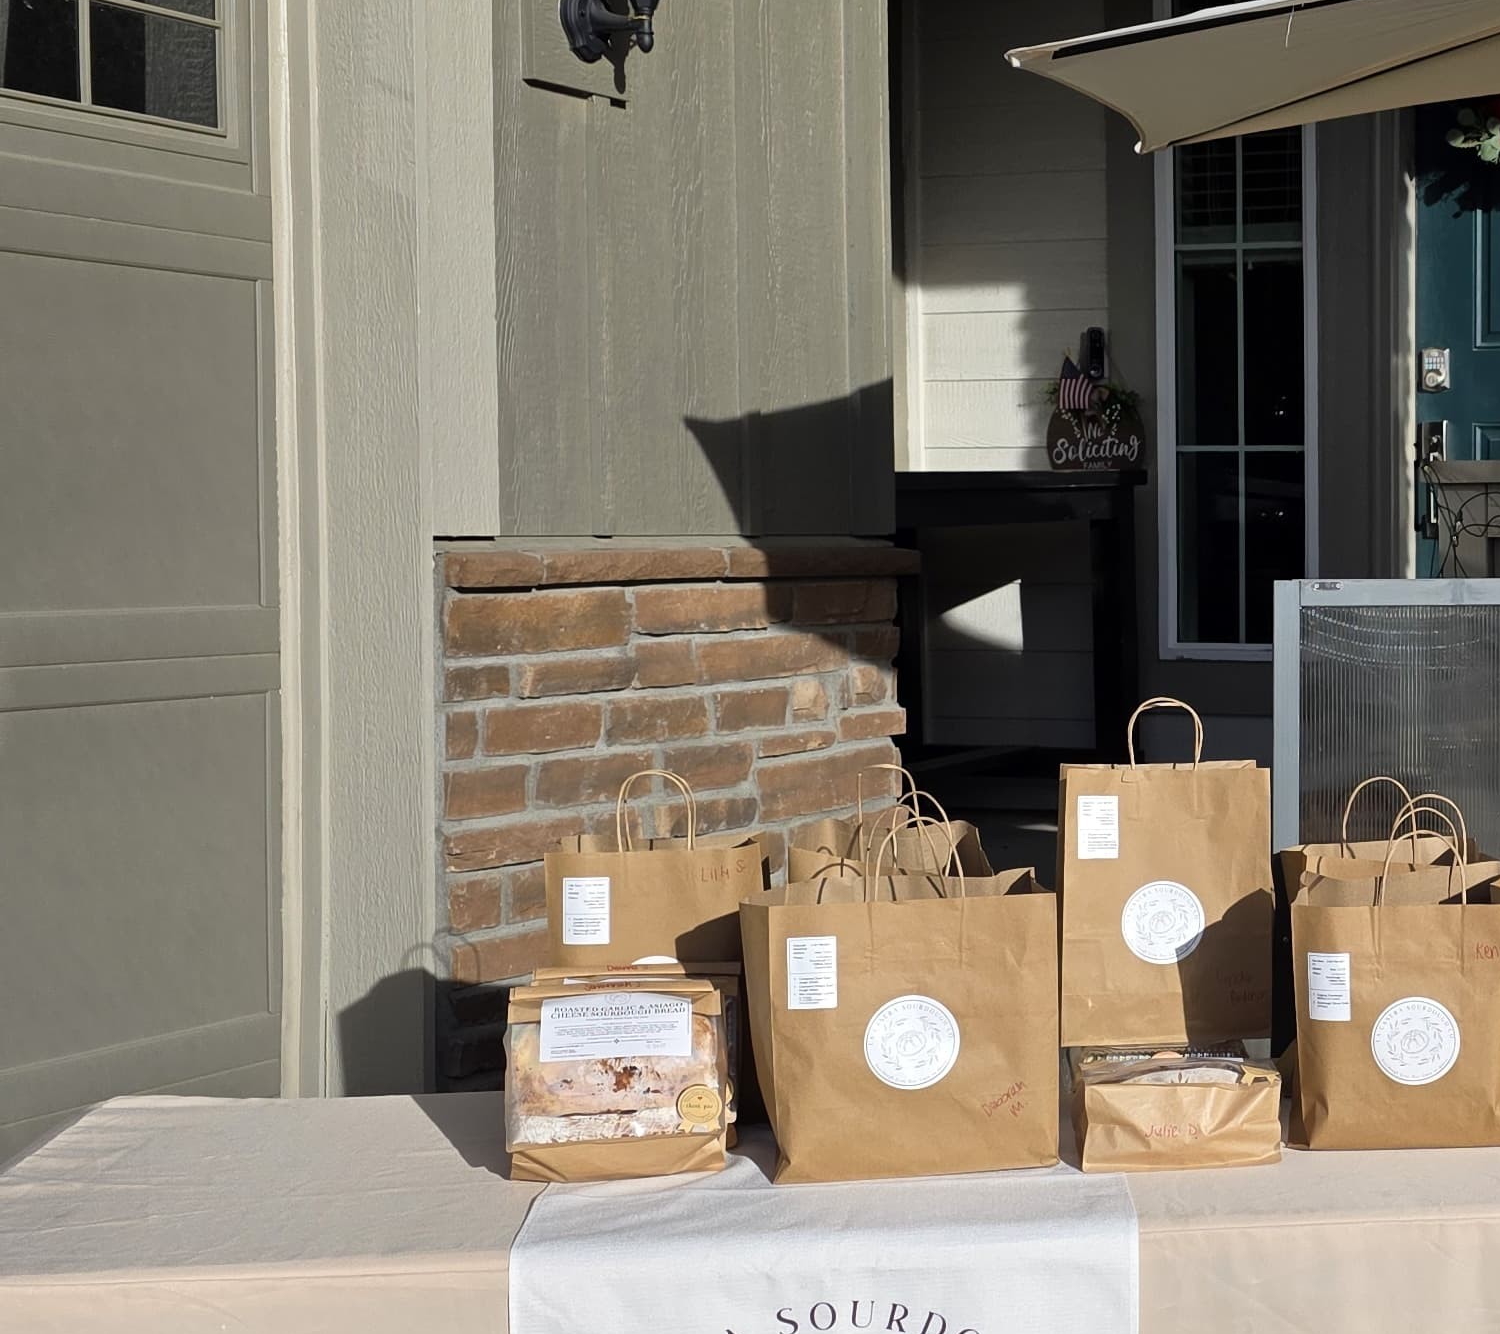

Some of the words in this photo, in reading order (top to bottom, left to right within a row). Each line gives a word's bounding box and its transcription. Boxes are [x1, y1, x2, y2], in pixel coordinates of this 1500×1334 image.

[1052, 434, 1140, 465] Soliciting
[1475, 941, 1500, 960] Ken
[1144, 1124, 1178, 1138] Julie
